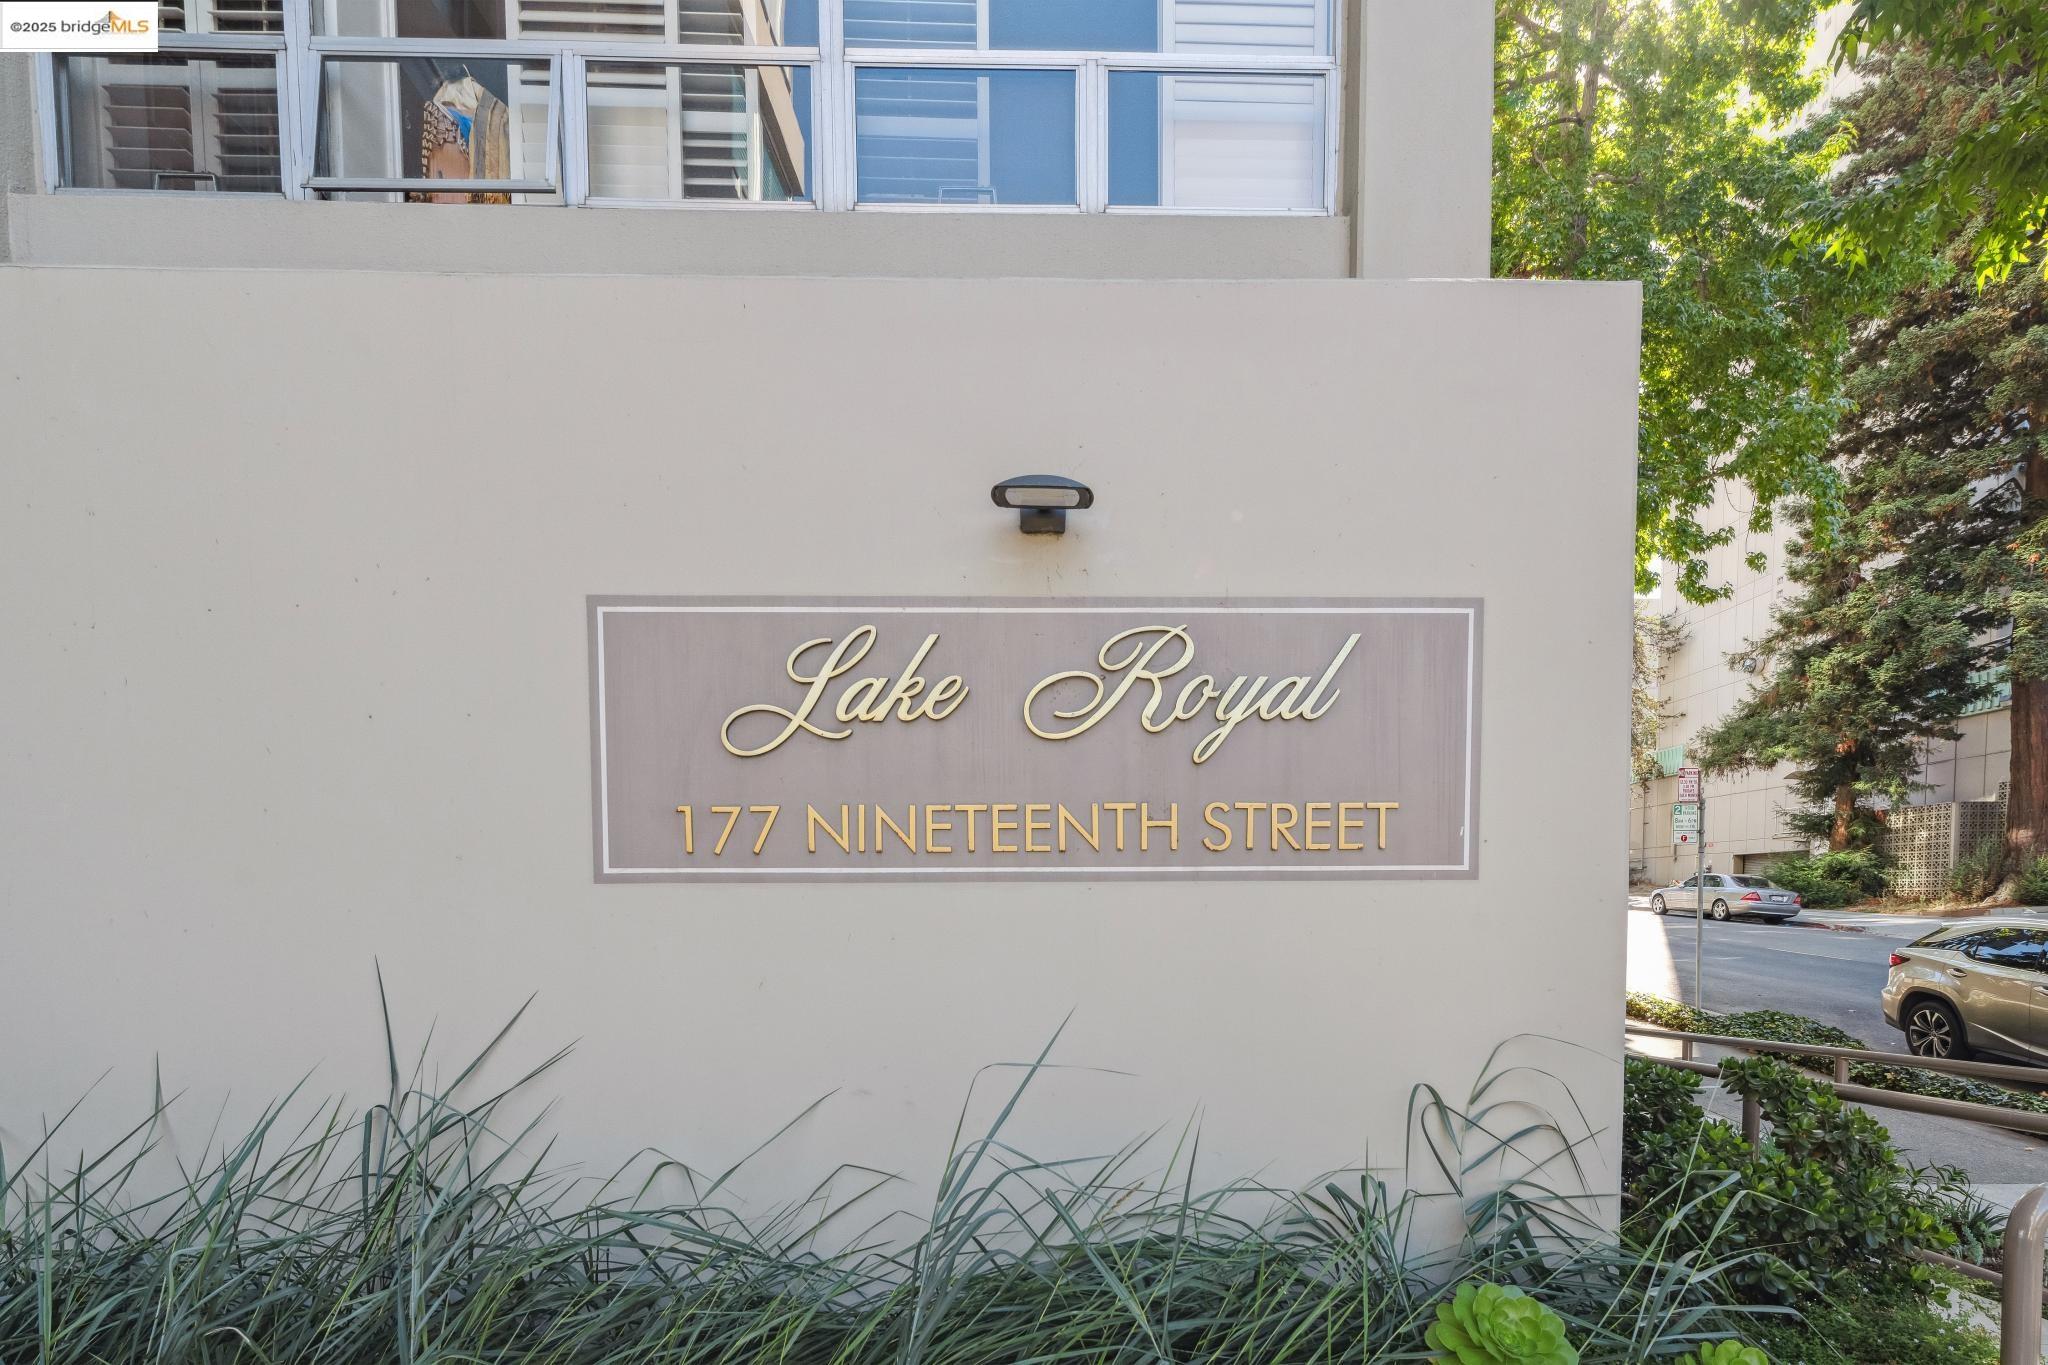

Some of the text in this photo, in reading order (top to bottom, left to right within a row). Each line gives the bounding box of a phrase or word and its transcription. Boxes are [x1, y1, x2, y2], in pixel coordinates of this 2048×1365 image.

[720, 624, 1361, 765] Lake Royal
[676, 801, 1401, 856] 177 NINETEENTH STREET
[1674, 805, 1681, 815] 2
